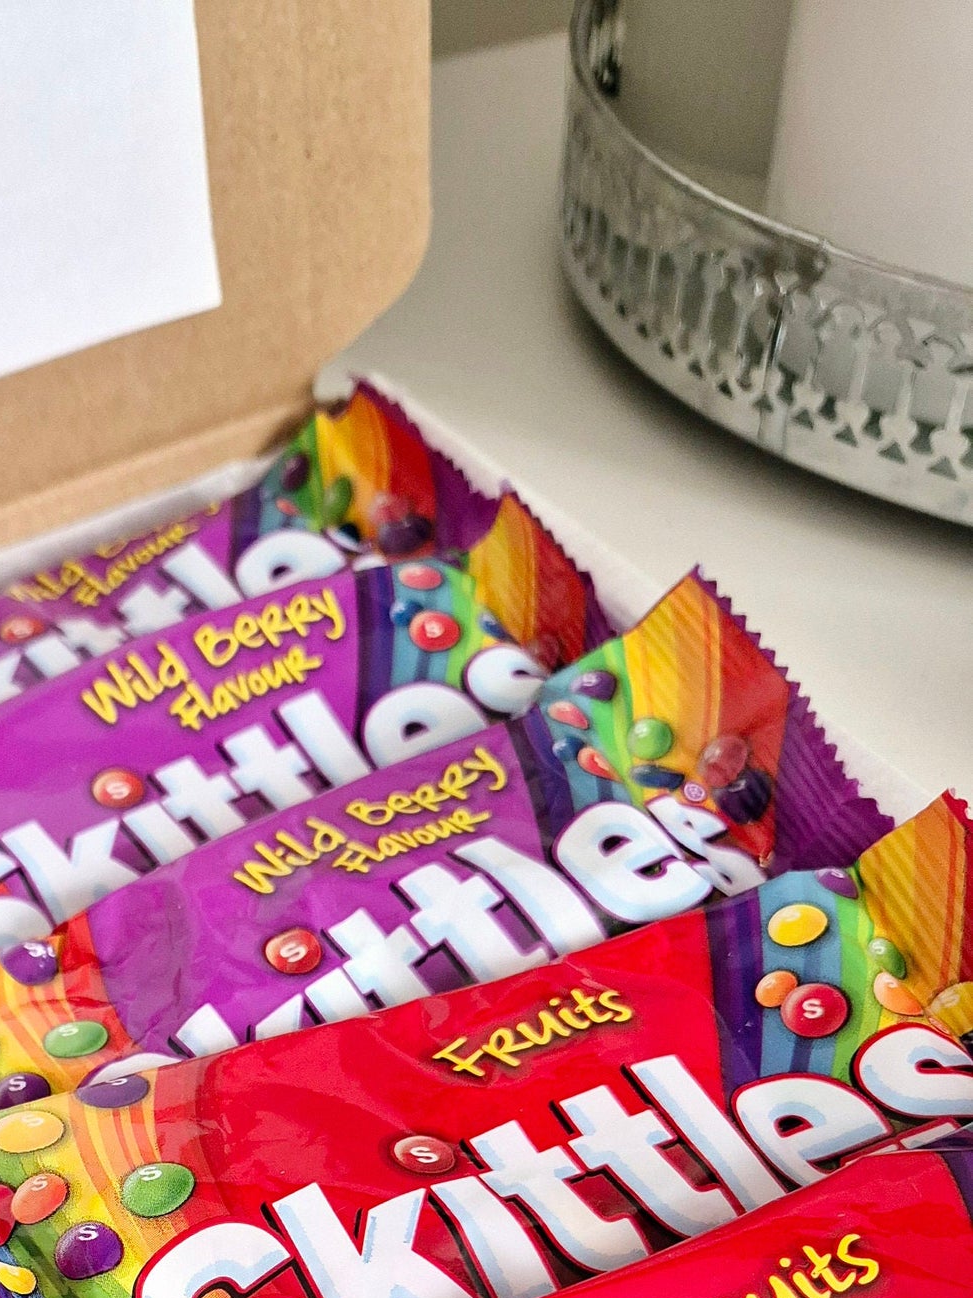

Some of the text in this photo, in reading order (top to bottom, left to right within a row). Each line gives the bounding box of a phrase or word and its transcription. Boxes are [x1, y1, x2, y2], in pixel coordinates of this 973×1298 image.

[81, 587, 347, 725] Wild Berry
[169, 643, 324, 731] Flavour
[232, 745, 508, 894] Wild Berry
[331, 806, 493, 874] Flavour
[77, 795, 767, 1092] ittles
[432, 987, 633, 1078] Fruits
